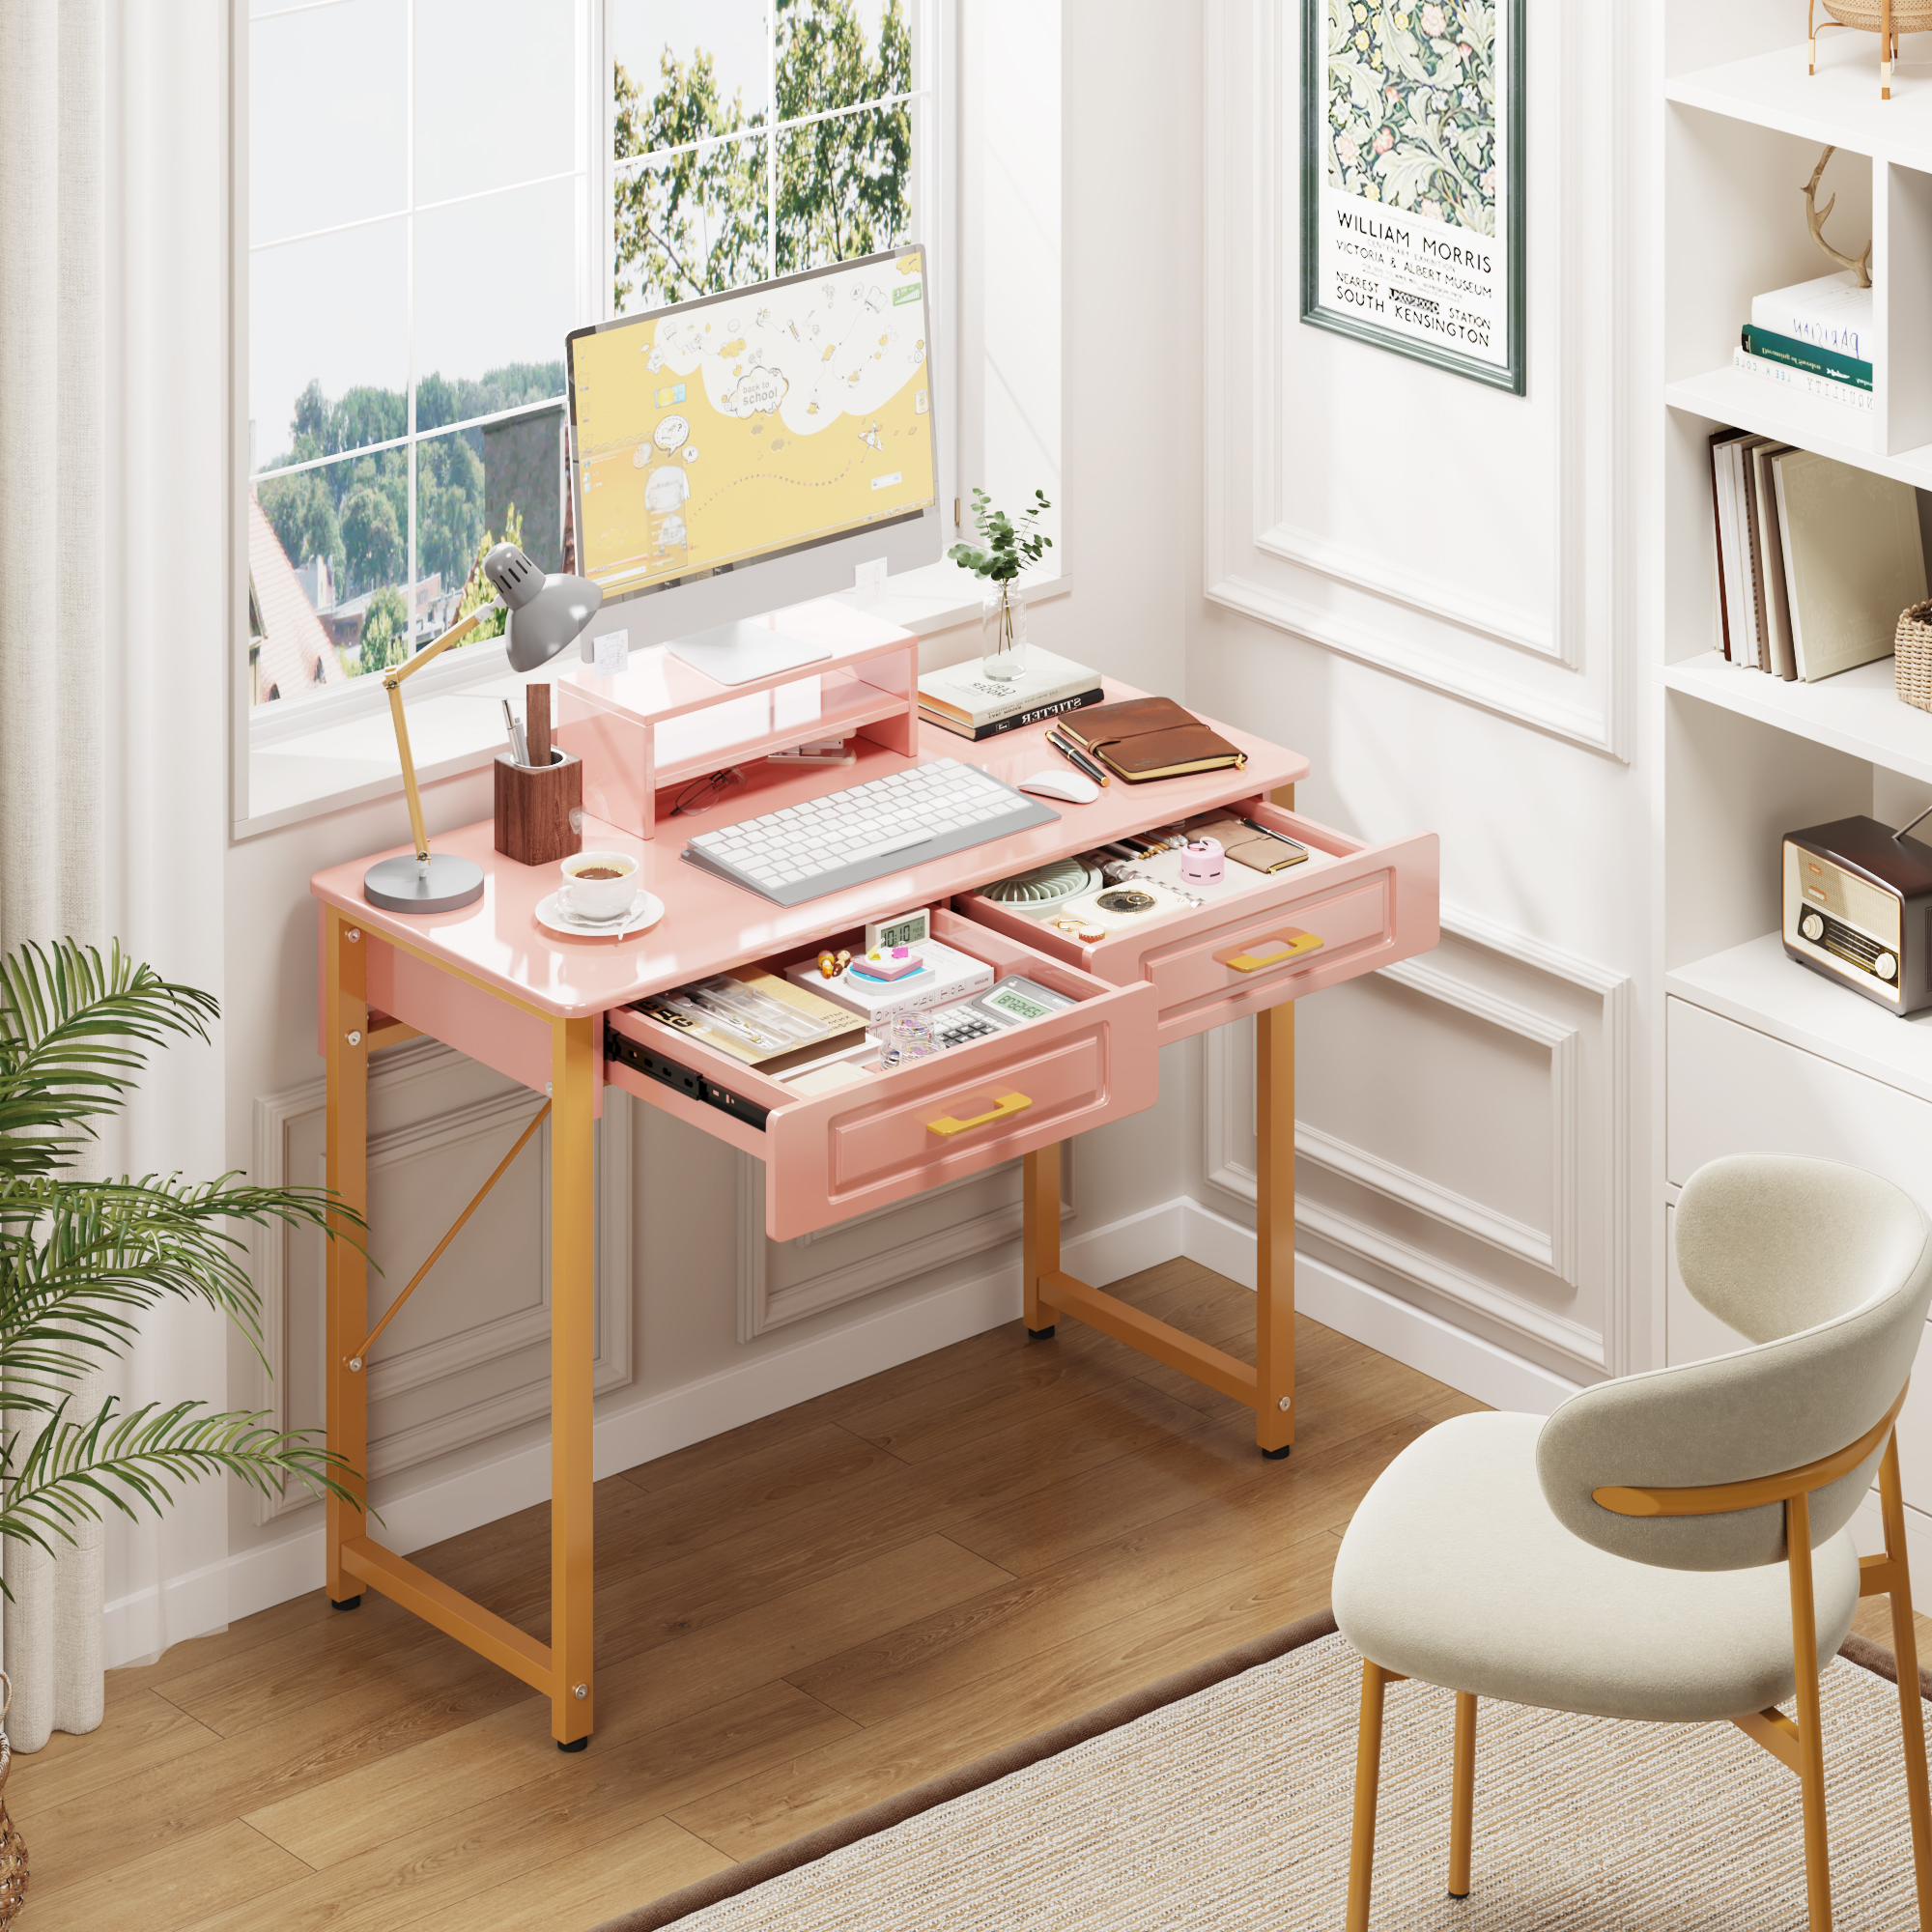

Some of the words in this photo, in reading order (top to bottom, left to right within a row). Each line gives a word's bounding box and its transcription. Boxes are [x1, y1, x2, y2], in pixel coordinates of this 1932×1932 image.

[1336, 240, 1384, 265] VICTORIA
[1390, 257, 1397, 269] &
[1404, 263, 1441, 281] ALBERT
[1445, 274, 1492, 298] MUSEUM
[1337, 210, 1409, 247] WILLIAM
[1423, 237, 1492, 273] MORRIS
[1336, 270, 1379, 293] NEAREST
[1449, 307, 1491, 329] STATION
[1336, 285, 1384, 313] SOUTH
[1395, 304, 1489, 347] KENSINGTON
[743, 383, 760, 394] back
[743, 386, 778, 406] school
[884, 924, 910, 948] 10:10
